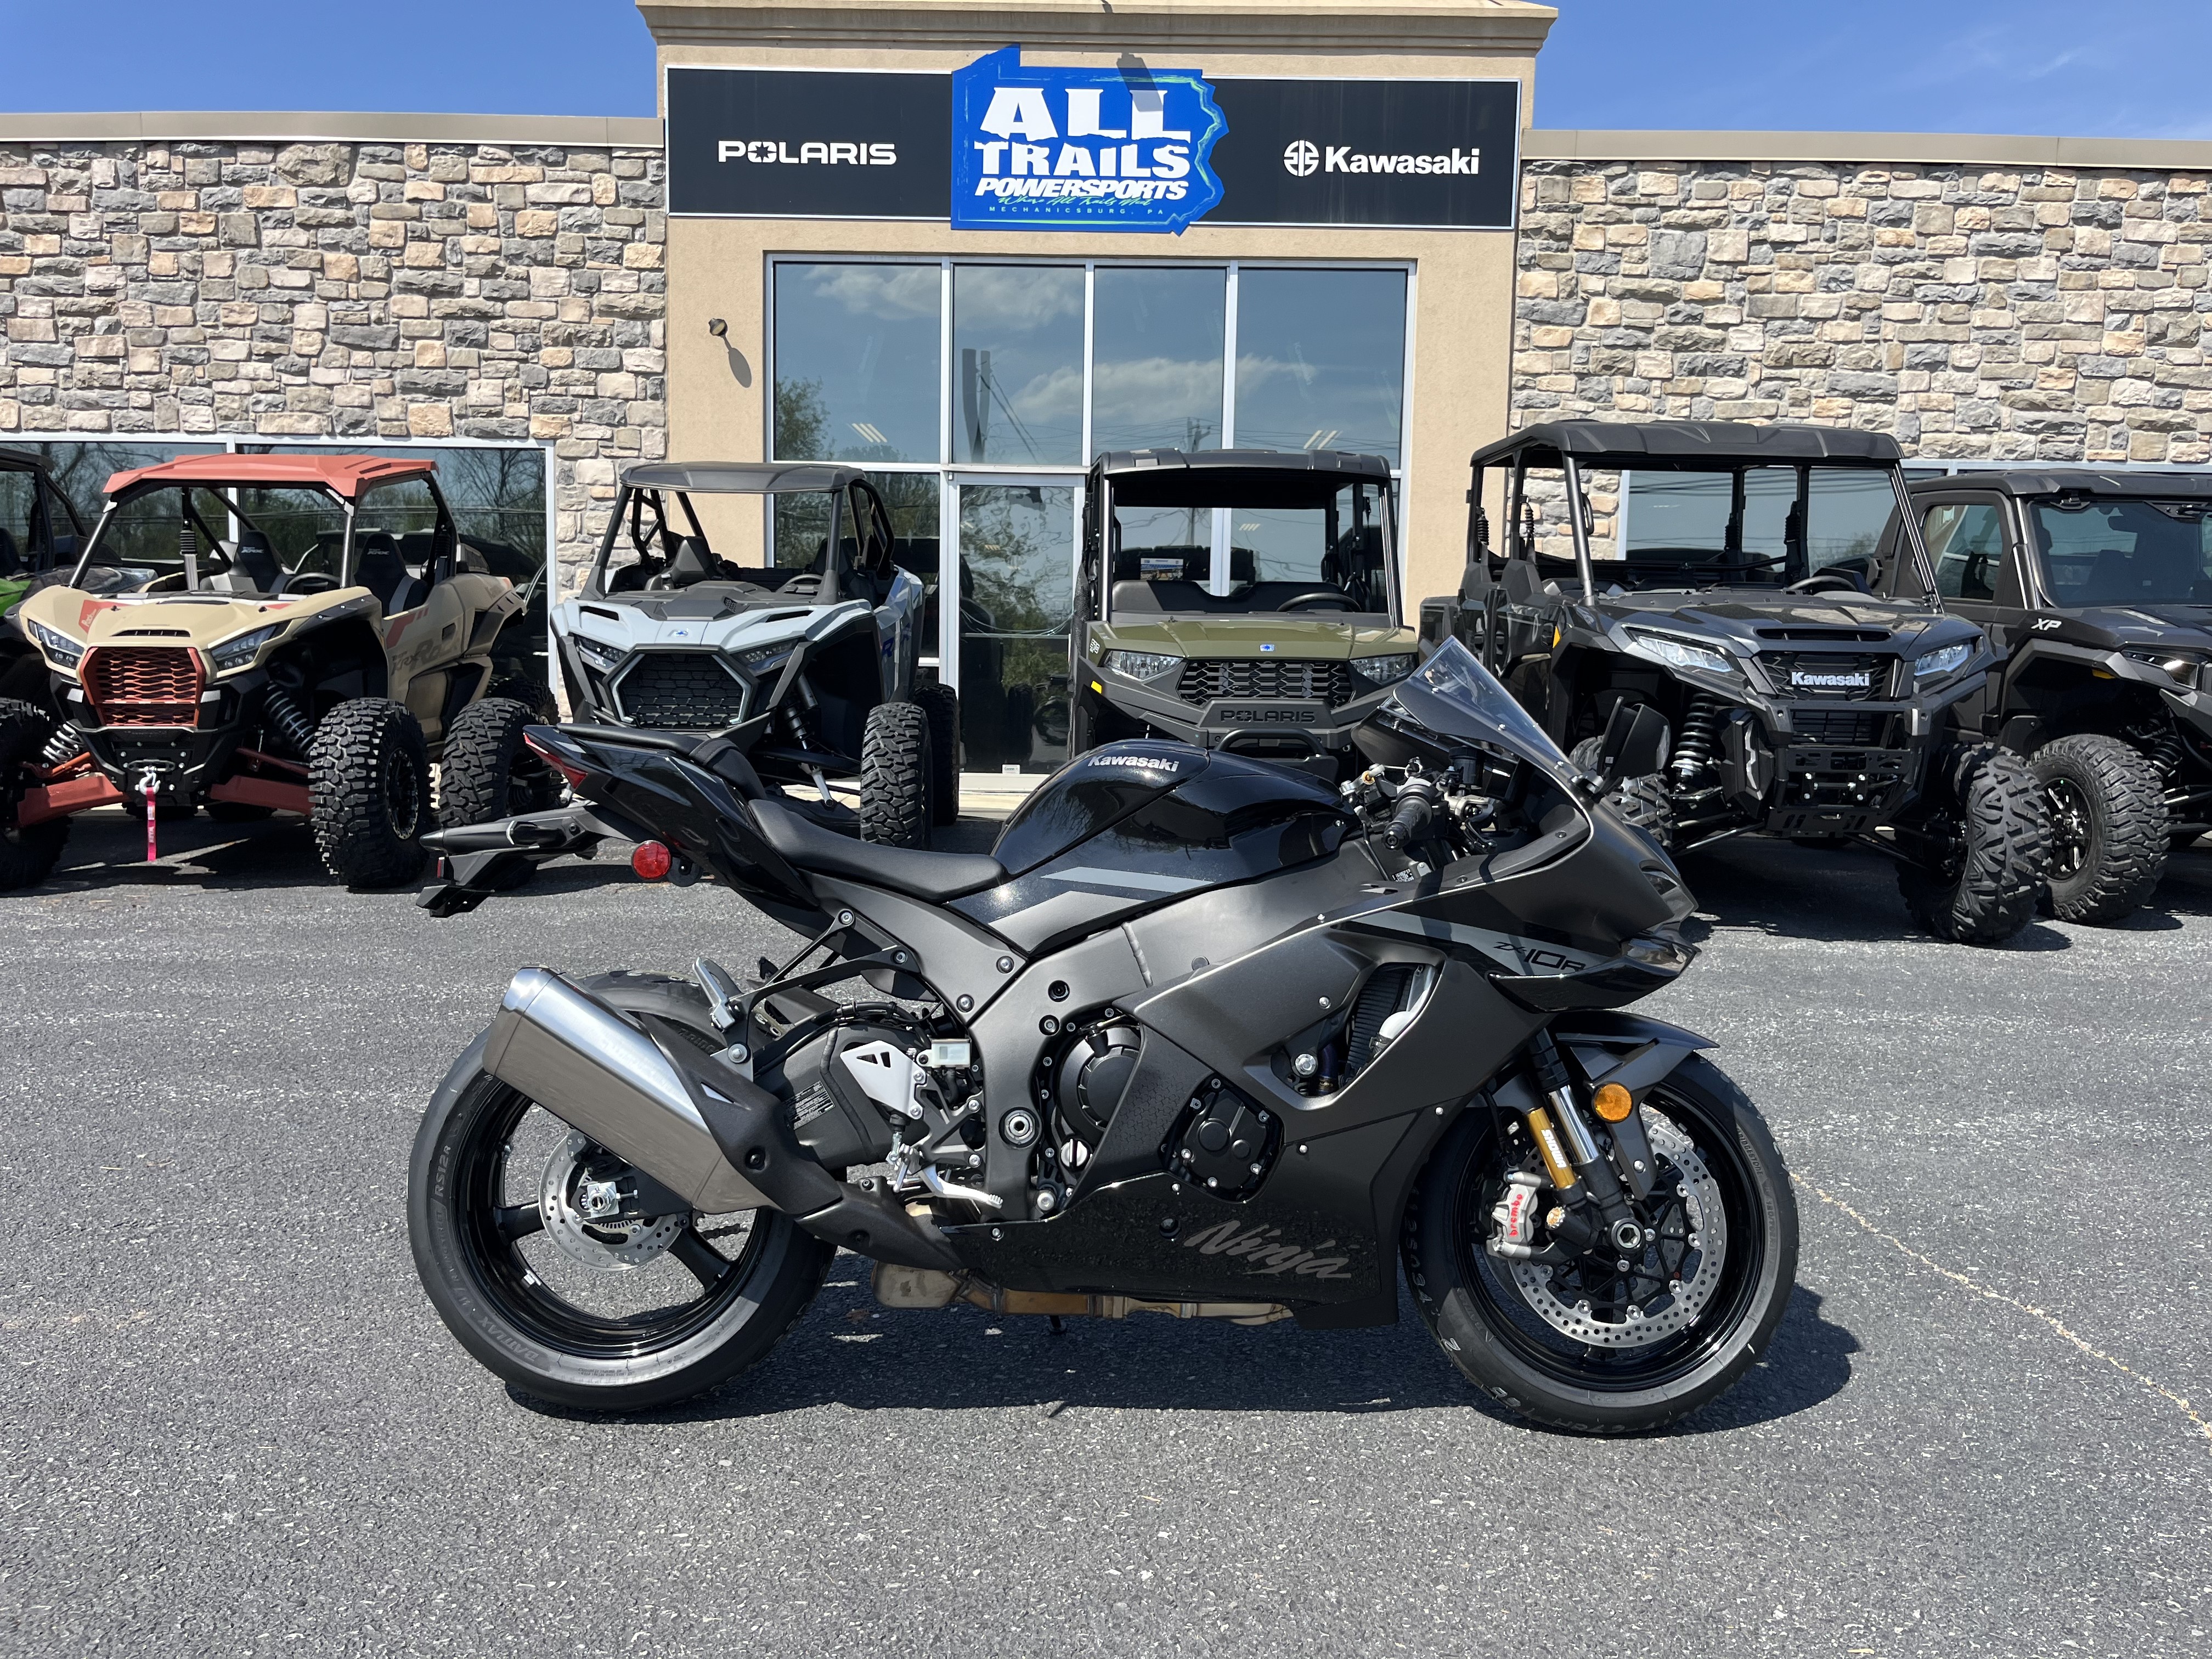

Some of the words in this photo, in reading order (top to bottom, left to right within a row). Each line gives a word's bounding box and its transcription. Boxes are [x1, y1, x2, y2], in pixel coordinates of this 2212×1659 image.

[980, 87, 1190, 143] ALL
[718, 140, 896, 165] POLARIS
[974, 141, 1190, 178] TRAILS
[1325, 146, 1480, 174] Kawasaki
[974, 178, 1189, 200] POWERSPORTS
[998, 195, 1045, 205] Where
[1046, 195, 1078, 205] All
[2031, 618, 2062, 631] XP
[1792, 672, 1870, 686] Kawasaki
[1221, 710, 1315, 722] POLARIS
[1088, 755, 1180, 772] Kawasaki
[1541, 1128, 1567, 1168] SHOWA
[433, 1145, 451, 1197] RS12R
[1510, 1194, 1523, 1237] brembo
[1183, 1220, 1352, 1278] Ninja
